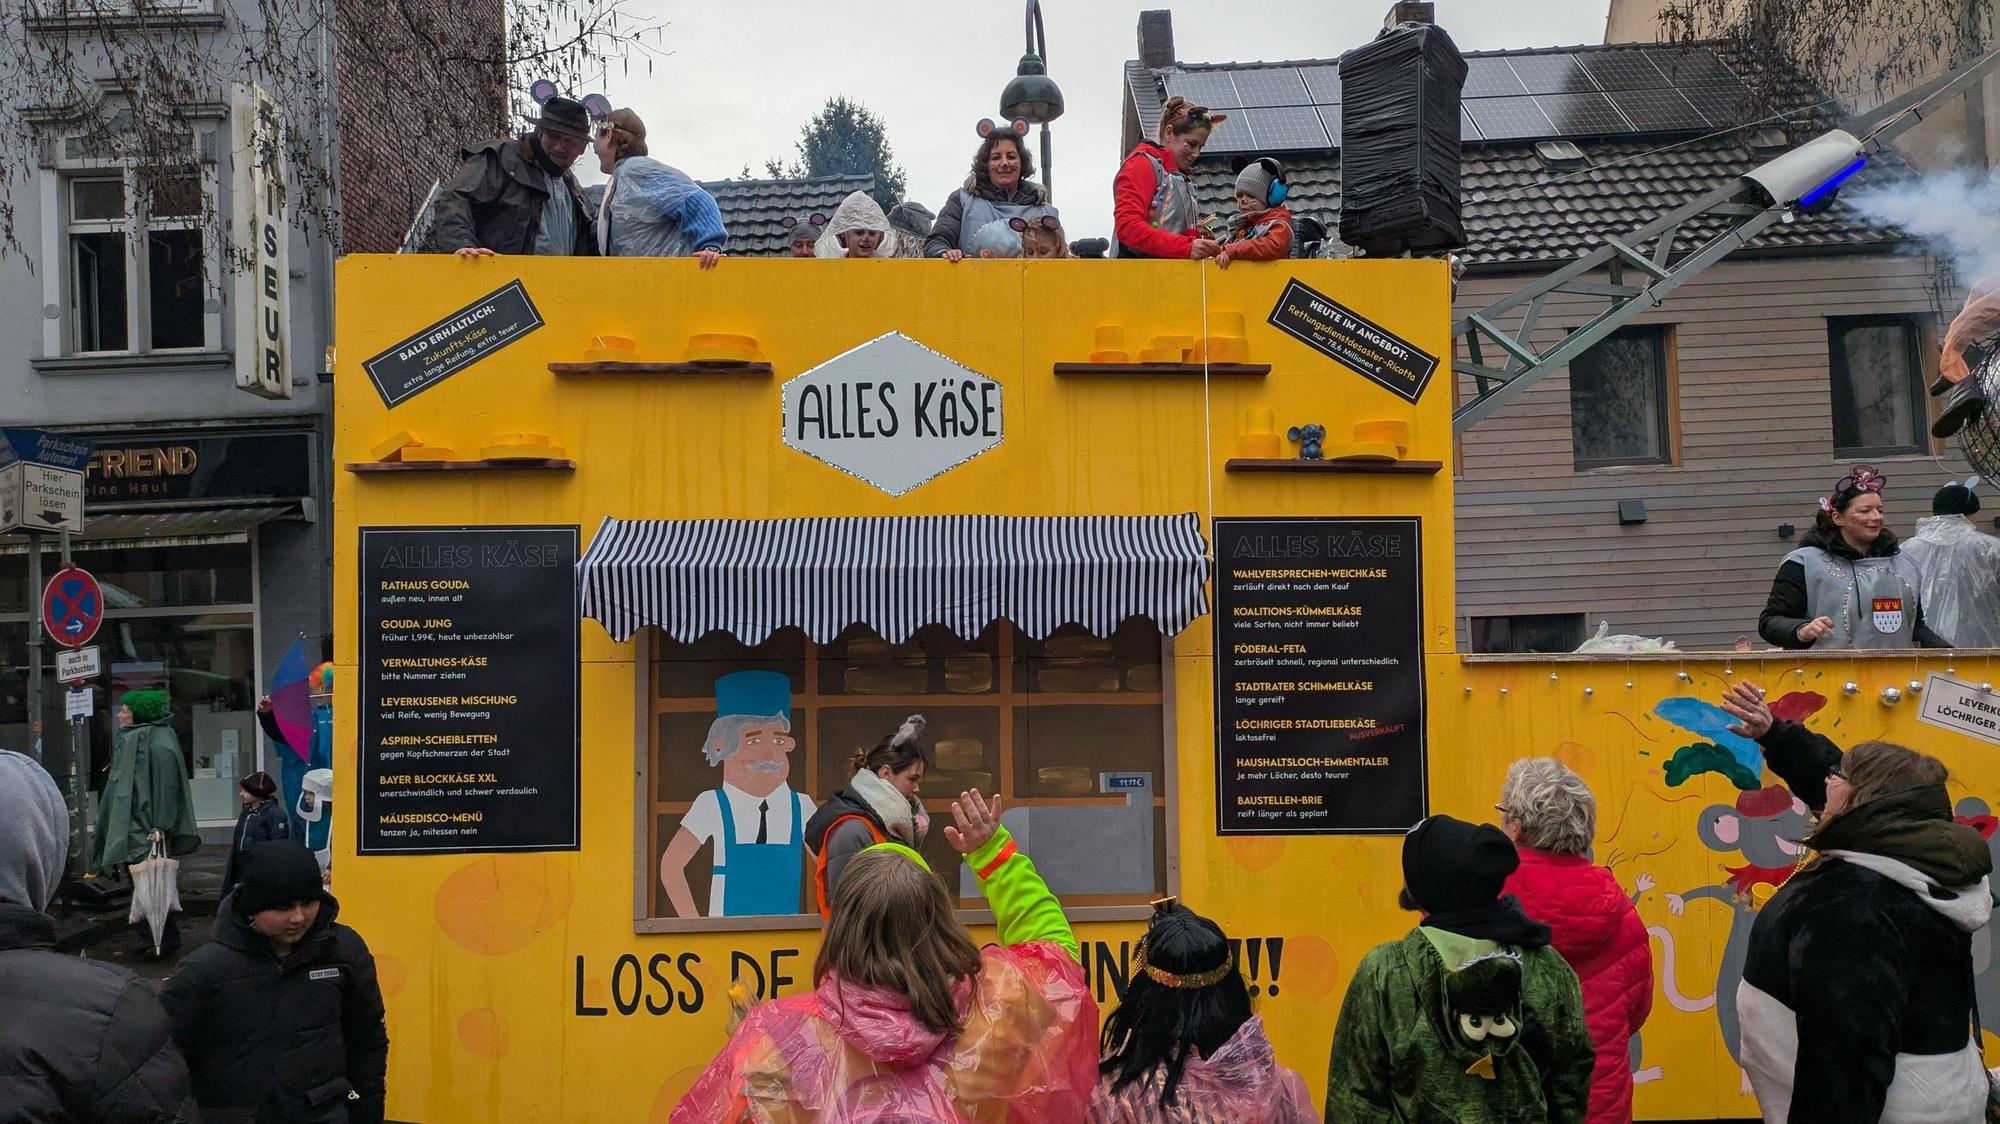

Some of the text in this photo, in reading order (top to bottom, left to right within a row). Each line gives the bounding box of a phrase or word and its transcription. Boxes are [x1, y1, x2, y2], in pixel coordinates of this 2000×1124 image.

[399, 305, 496, 361] BALD ERHÄLTLICH:
[1310, 300, 1408, 361] HEUTE IM ANGEBOT:
[423, 327, 487, 365] Zukunfts-Käse
[1288, 305, 1416, 381] Rettungsdienstdesaster-Ricotta
[403, 322, 518, 389] extra lange Reifung, extra teuer
[1313, 332, 1325, 342] nur
[1328, 339, 1341, 351] 78,6
[1343, 348, 1373, 369] Millionen
[798, 378, 997, 440] ALLES KÄSE
[37, 435, 89, 456] Parkschein
[37, 449, 77, 467] Automat
[42, 472, 64, 483] Hier
[26, 482, 79, 499] Parkschein
[129, 482, 168, 494] Haut
[40, 496, 66, 510] lösen
[1233, 530, 1401, 558] ALLES KÄSE
[381, 540, 558, 568] ALLES KÄSE
[1233, 568, 1388, 578] WAHLVERSPRECHEN-WEICHKÄSE
[381, 580, 469, 590] RATHAUS GOUDA
[1233, 583, 1265, 591] zerläuft
[1267, 583, 1291, 591] direkt
[1293, 583, 1311, 591] nach
[381, 595, 406, 604] außen
[1234, 605, 1362, 616] KOALITIONS-KÜMMELKÄSE
[381, 619, 452, 629] GOUDA JUNG
[1254, 621, 1282, 629] Sorten,
[1333, 620, 1360, 628] beliebt
[438, 633, 461, 641] heute
[464, 632, 514, 640] unbezahlbar
[1234, 643, 1307, 653] FÖDERAL-FETA
[381, 657, 488, 667] VERWALTUNGS-KÄSE
[1234, 657, 1399, 667] zerbröselt schnell, regional unterschiedlich
[381, 672, 400, 680] bitte
[403, 672, 437, 680] Nummer
[1297, 680, 1373, 690] SCHIMMELKÄSE
[381, 695, 517, 707] LEVERKUSENER MISCHUNG
[1235, 696, 1285, 705] lange gereift
[1959, 696, 2000, 716] LEVERK
[381, 711, 490, 720] viel Reife, wenig Bewegung
[1937, 705, 1996, 730] LÖCHRIGER
[1236, 718, 1376, 729] LÖCHRIGER STADTLIEBEKÄSE
[381, 735, 498, 745] ASPIRIN-SCHEIBLETTEN
[1235, 734, 1277, 742] laktosefrei
[380, 749, 511, 760] gegen Kopfschmerzen der Stadt
[1237, 757, 1389, 767] HAUSHALTSLOCH-EMMENTALER
[379, 772, 498, 785] BAYER BLOCKKÄSE XXL
[1270, 772, 1299, 780] Löcher,
[1301, 771, 1323, 779] desto
[379, 789, 444, 797] unerschwindlich
[496, 787, 538, 795] verdaulich
[1238, 795, 1323, 805] BAUSTELLEN-BRIE
[380, 812, 483, 824] MÄUSEDISCO-MENÜ
[1237, 809, 1328, 819] reift länger als geplant
[380, 829, 407, 837] tanzen
[409, 829, 421, 837] ja,
[423, 828, 458, 836] mitessen
[575, 952, 704, 1016] LOSS
